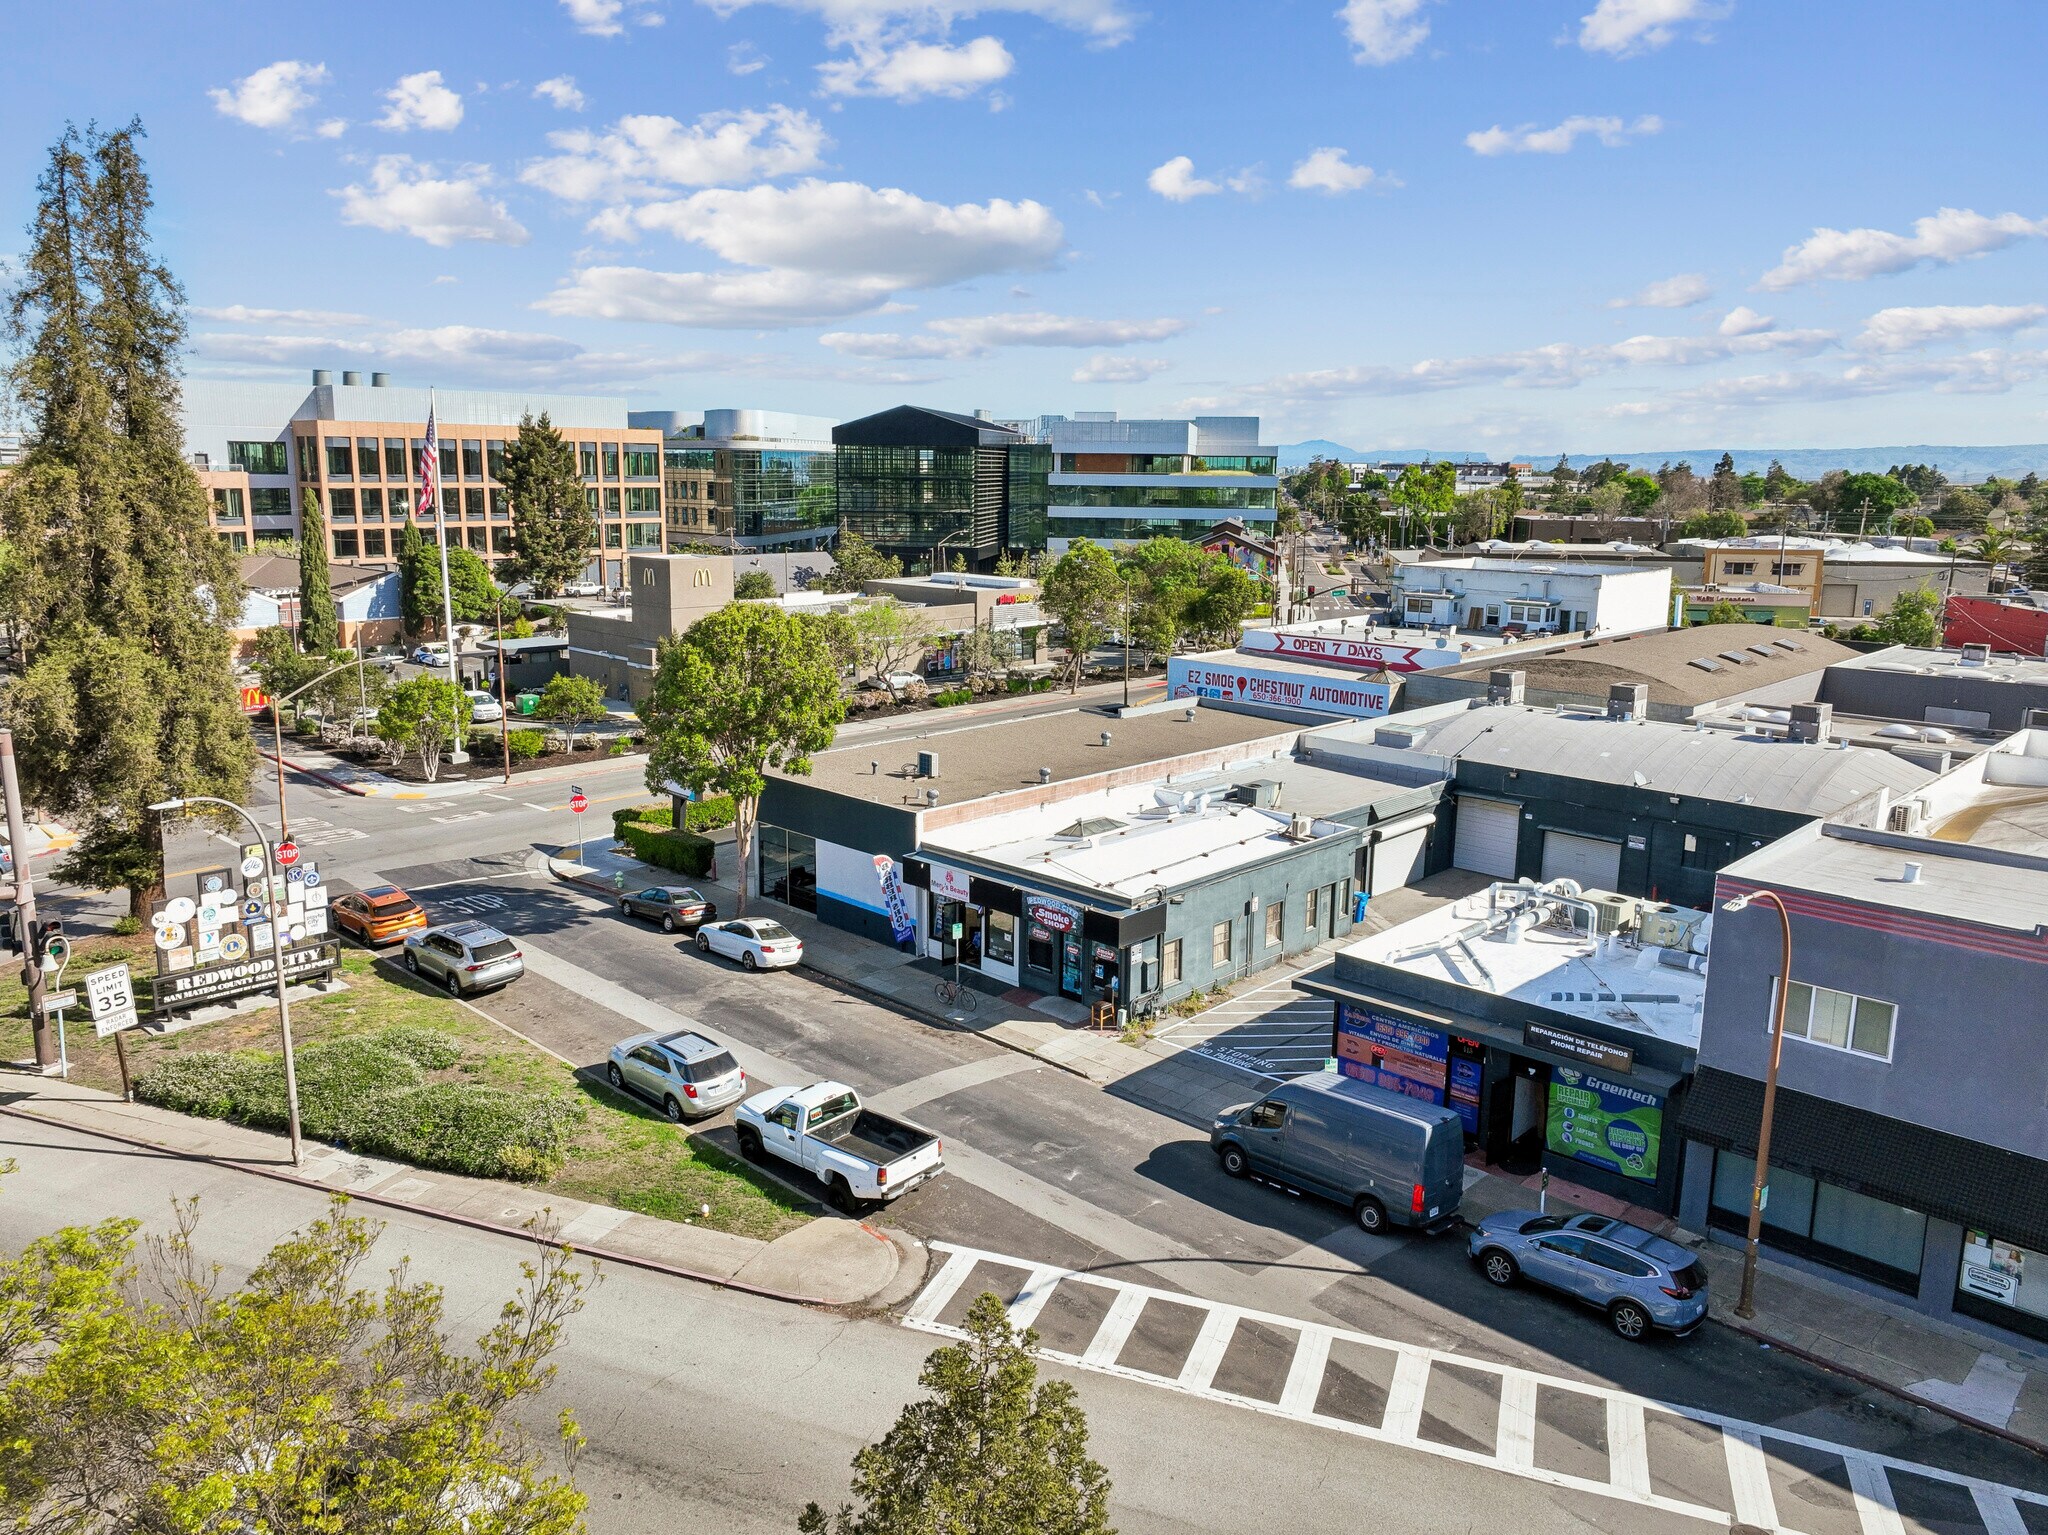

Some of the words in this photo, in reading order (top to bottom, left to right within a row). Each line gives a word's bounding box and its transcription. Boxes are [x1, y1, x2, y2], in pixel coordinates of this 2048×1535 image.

[1293, 639, 1325, 653] OPEN
[1332, 643, 1342, 655] 7
[1348, 644, 1383, 660] DAYS
[1188, 670, 1201, 684] EZ
[1205, 672, 1235, 688] SMOG
[1249, 678, 1305, 698] CHESTNUT
[1309, 686, 1384, 710] AUTOMOTIVE
[1252, 692, 1302, 706] 650-366-1900
[570, 799, 588, 809] STOP
[276, 849, 299, 860] STOP
[244, 859, 261, 872] Elks
[881, 862, 898, 902] BARBER
[891, 903, 905, 929] SHOP
[950, 885, 969, 898] Beauty
[439, 893, 509, 915] STOP
[1027, 895, 1061, 909] REDWOOD
[1060, 903, 1079, 918] CITY
[1038, 908, 1070, 925] Smoke
[1043, 918, 1066, 930] SHOP
[90, 970, 125, 986] SPEED
[175, 959, 275, 992] REDWOOD
[281, 948, 320, 968] CITY
[96, 981, 124, 995] LIMIT
[163, 992, 183, 1003] SAN
[183, 985, 217, 1000] MATEO
[217, 976, 255, 991] COUNTY
[255, 971, 278, 982] SEAT
[311, 957, 336, 969] PORT
[98, 991, 127, 1012] 35
[101, 1017, 134, 1035] ENFORCED
[106, 1013, 127, 1024] RADAR
[1371, 1015, 1397, 1026] CENTRO
[1397, 1024, 1439, 1040] AMERICANOS
[1348, 1030, 1377, 1043] VITAMINAS
[1381, 1041, 1414, 1054] PRODUCTOS
[1414, 1050, 1447, 1064] NATURALES
[1371, 1044, 1388, 1056] OPEN
[1400, 1038, 1423, 1051] DINERO
[1457, 1036, 1480, 1048] OPEN
[1530, 1026, 1574, 1043] REPARACIÓN
[1575, 1037, 1586, 1046] DE
[1586, 1040, 1629, 1058] TELÉFONOS
[1550, 1039, 1576, 1052] PHONE
[1576, 1046, 1603, 1059] REPAIR
[1197, 1046, 1214, 1055] NO
[1213, 1053, 1254, 1068] PARKING
[1217, 1046, 1276, 1069] STOPPING
[1557, 1085, 1590, 1101] REPAIR
[1586, 1076, 1657, 1106] Greentech
[1557, 1095, 1590, 1108] SPECIALIST
[1577, 1113, 1598, 1125] TABLETS
[1575, 1126, 1598, 1139] LAPTOPS
[1574, 1137, 1595, 1149] PHONES
[1609, 1140, 1622, 1150] FREE
[1622, 1143, 1636, 1152] DROP
[1635, 1145, 1645, 1153] OFF
